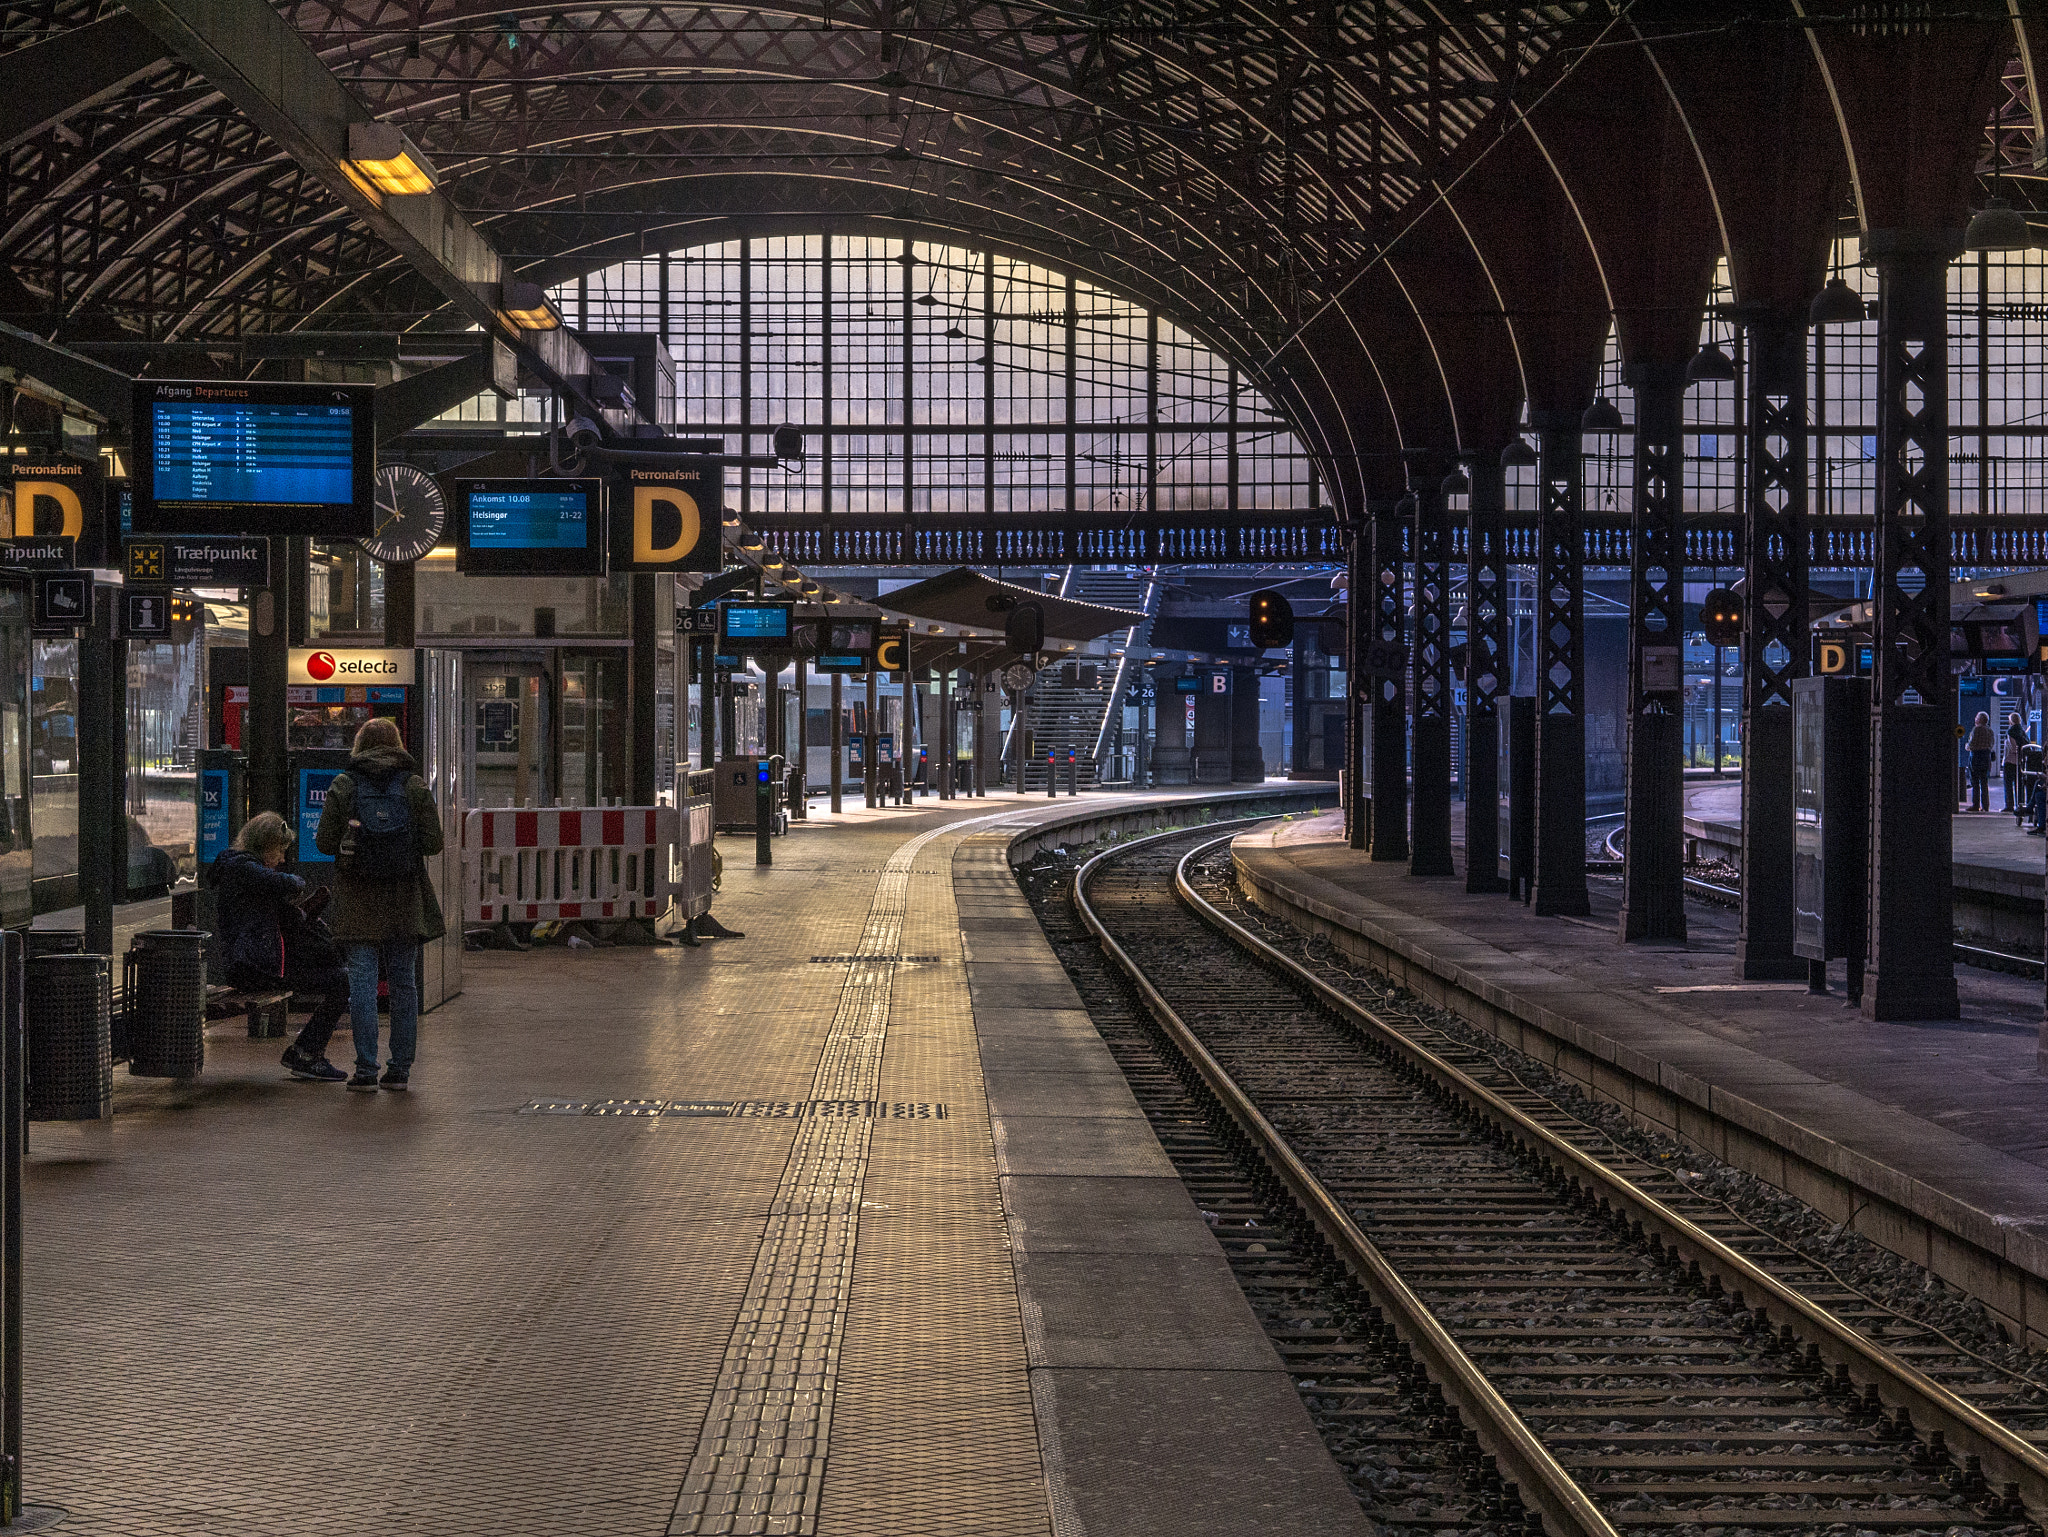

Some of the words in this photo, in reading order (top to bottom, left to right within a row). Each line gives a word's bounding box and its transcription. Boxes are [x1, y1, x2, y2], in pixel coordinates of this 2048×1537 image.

[156, 386, 192, 398] Afgang
[195, 387, 249, 398] Departures
[12, 464, 83, 475] Perronafsnit
[631, 469, 700, 480] Perronafsnit
[472, 495, 506, 503] Ankomst
[508, 495, 531, 503] 10.08
[15, 481, 83, 543] D
[472, 511, 508, 521] Helsingør
[559, 511, 583, 520] 21-22
[633, 486, 701, 563] D
[174, 545, 258, 563] Træfpunkt
[676, 617, 693, 630] 26
[877, 640, 900, 670] C
[1820, 644, 1846, 673] D
[338, 659, 398, 674] selecta
[1213, 675, 1227, 693] B
[1992, 677, 2007, 696] C
[1141, 688, 1155, 698] 26
